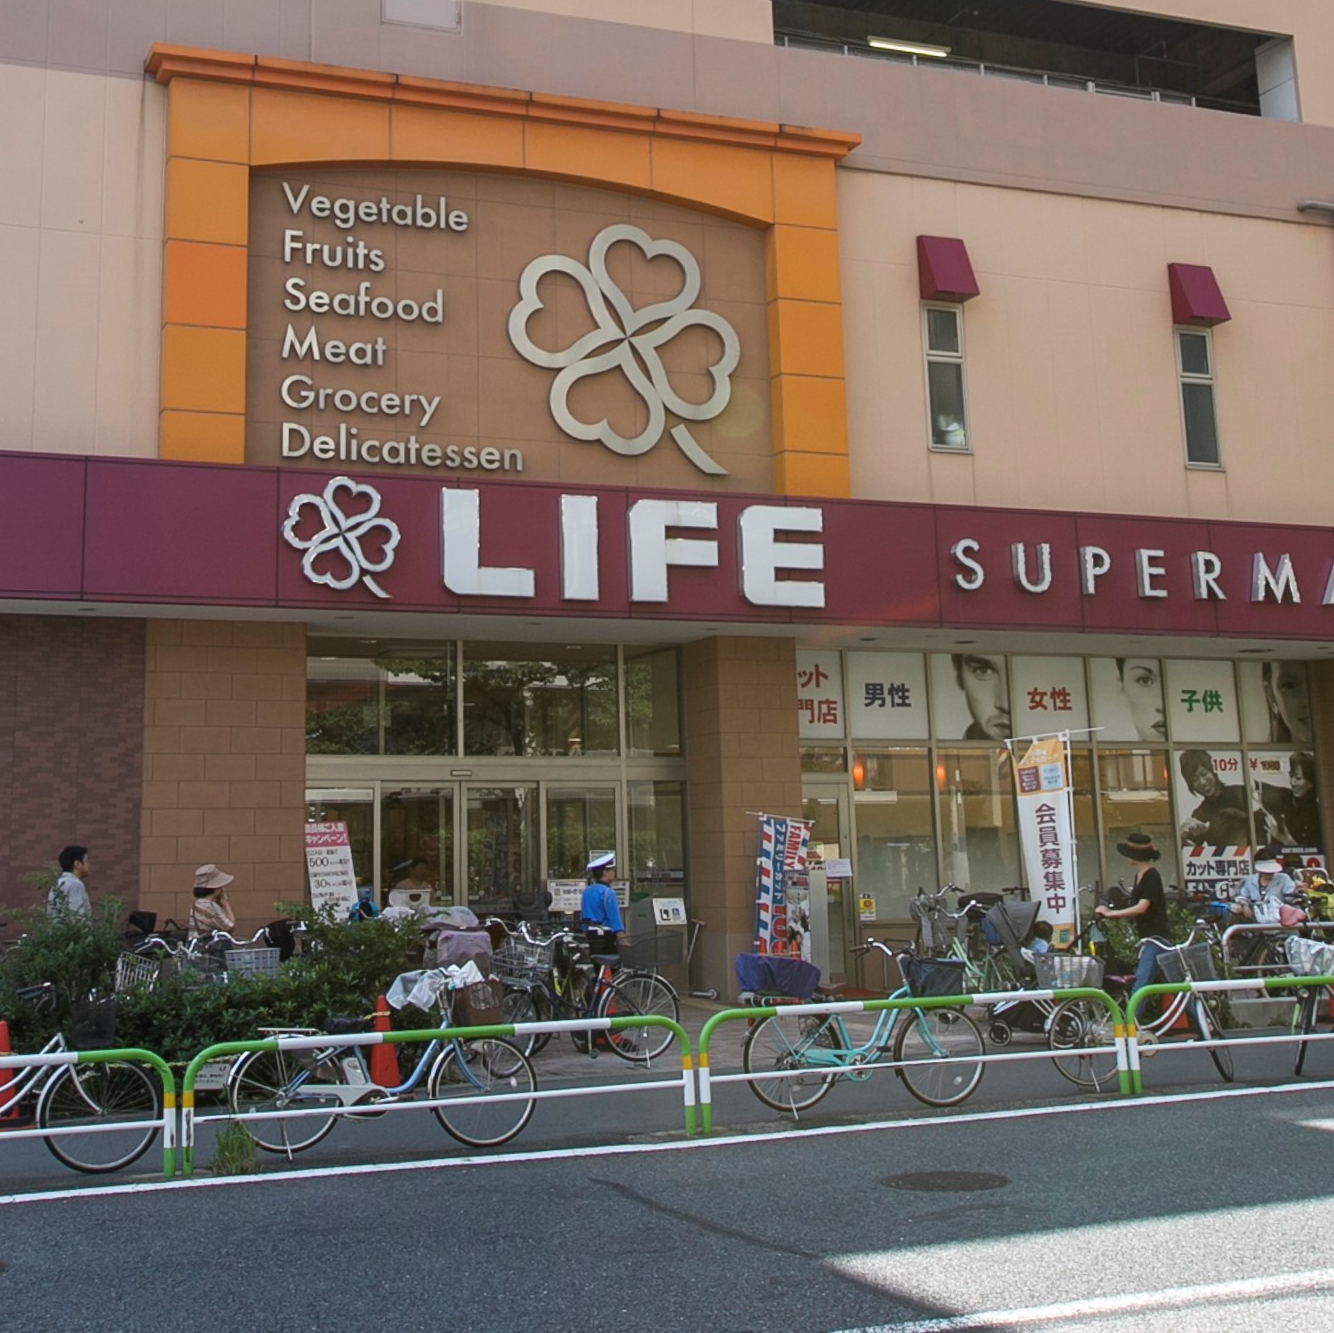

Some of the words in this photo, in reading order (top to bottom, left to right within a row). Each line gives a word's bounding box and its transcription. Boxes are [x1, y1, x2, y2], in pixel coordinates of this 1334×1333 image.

[282, 182, 469, 231] Vegetable
[283, 229, 385, 272] Fruits
[283, 277, 444, 323] Seafood
[281, 323, 387, 366] Meat
[280, 374, 441, 427] Grocery
[281, 422, 524, 471] Delicatessen
[440, 486, 826, 608] LIFE
[864, 682, 911, 709] 男性
[1027, 687, 1073, 712] 女性
[1180, 689, 1224, 714] 子供
[1213, 758, 1239, 772] 10分
[784, 824, 802, 870] FAMILY
[1034, 802, 1067, 914] 会員募集中
[1186, 860, 1250, 877] カット専門店
